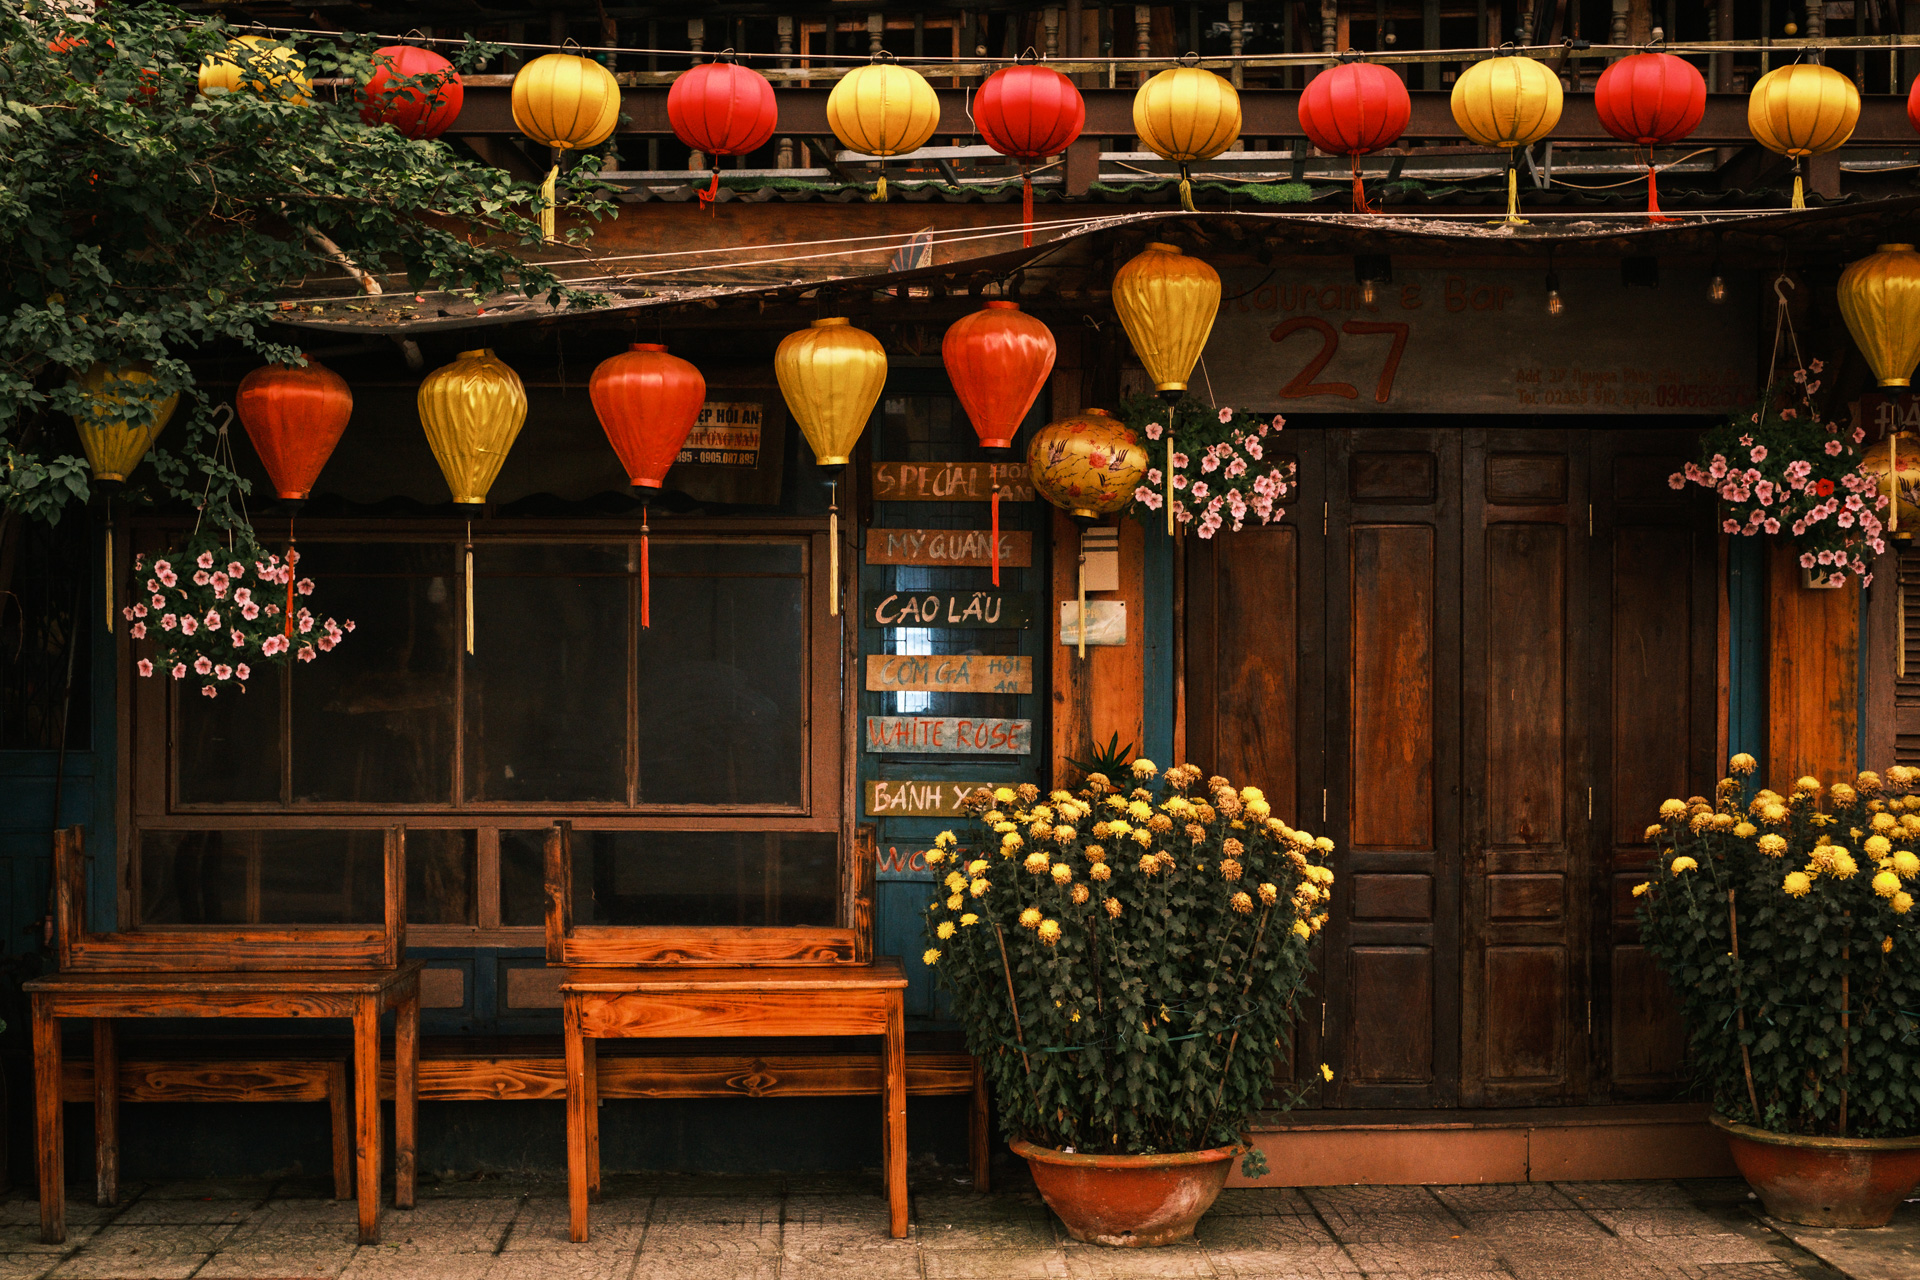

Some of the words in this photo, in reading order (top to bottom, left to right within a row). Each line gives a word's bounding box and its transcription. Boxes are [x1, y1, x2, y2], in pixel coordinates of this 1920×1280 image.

[1444, 274, 1515, 311] Bar
[1269, 315, 1411, 404] 27
[716, 407, 738, 426] HỘI
[742, 410, 759, 425] AN
[699, 451, 755, 465] 0905.087.895
[877, 462, 983, 497] SPECIAL
[875, 594, 940, 624] CAO
[948, 591, 1002, 624] LẦU
[935, 656, 973, 685] GÀ
[988, 656, 1021, 677] HỘI
[994, 680, 1019, 693] AN
[868, 716, 945, 748] WHITE
[957, 720, 1025, 750] ROSE
